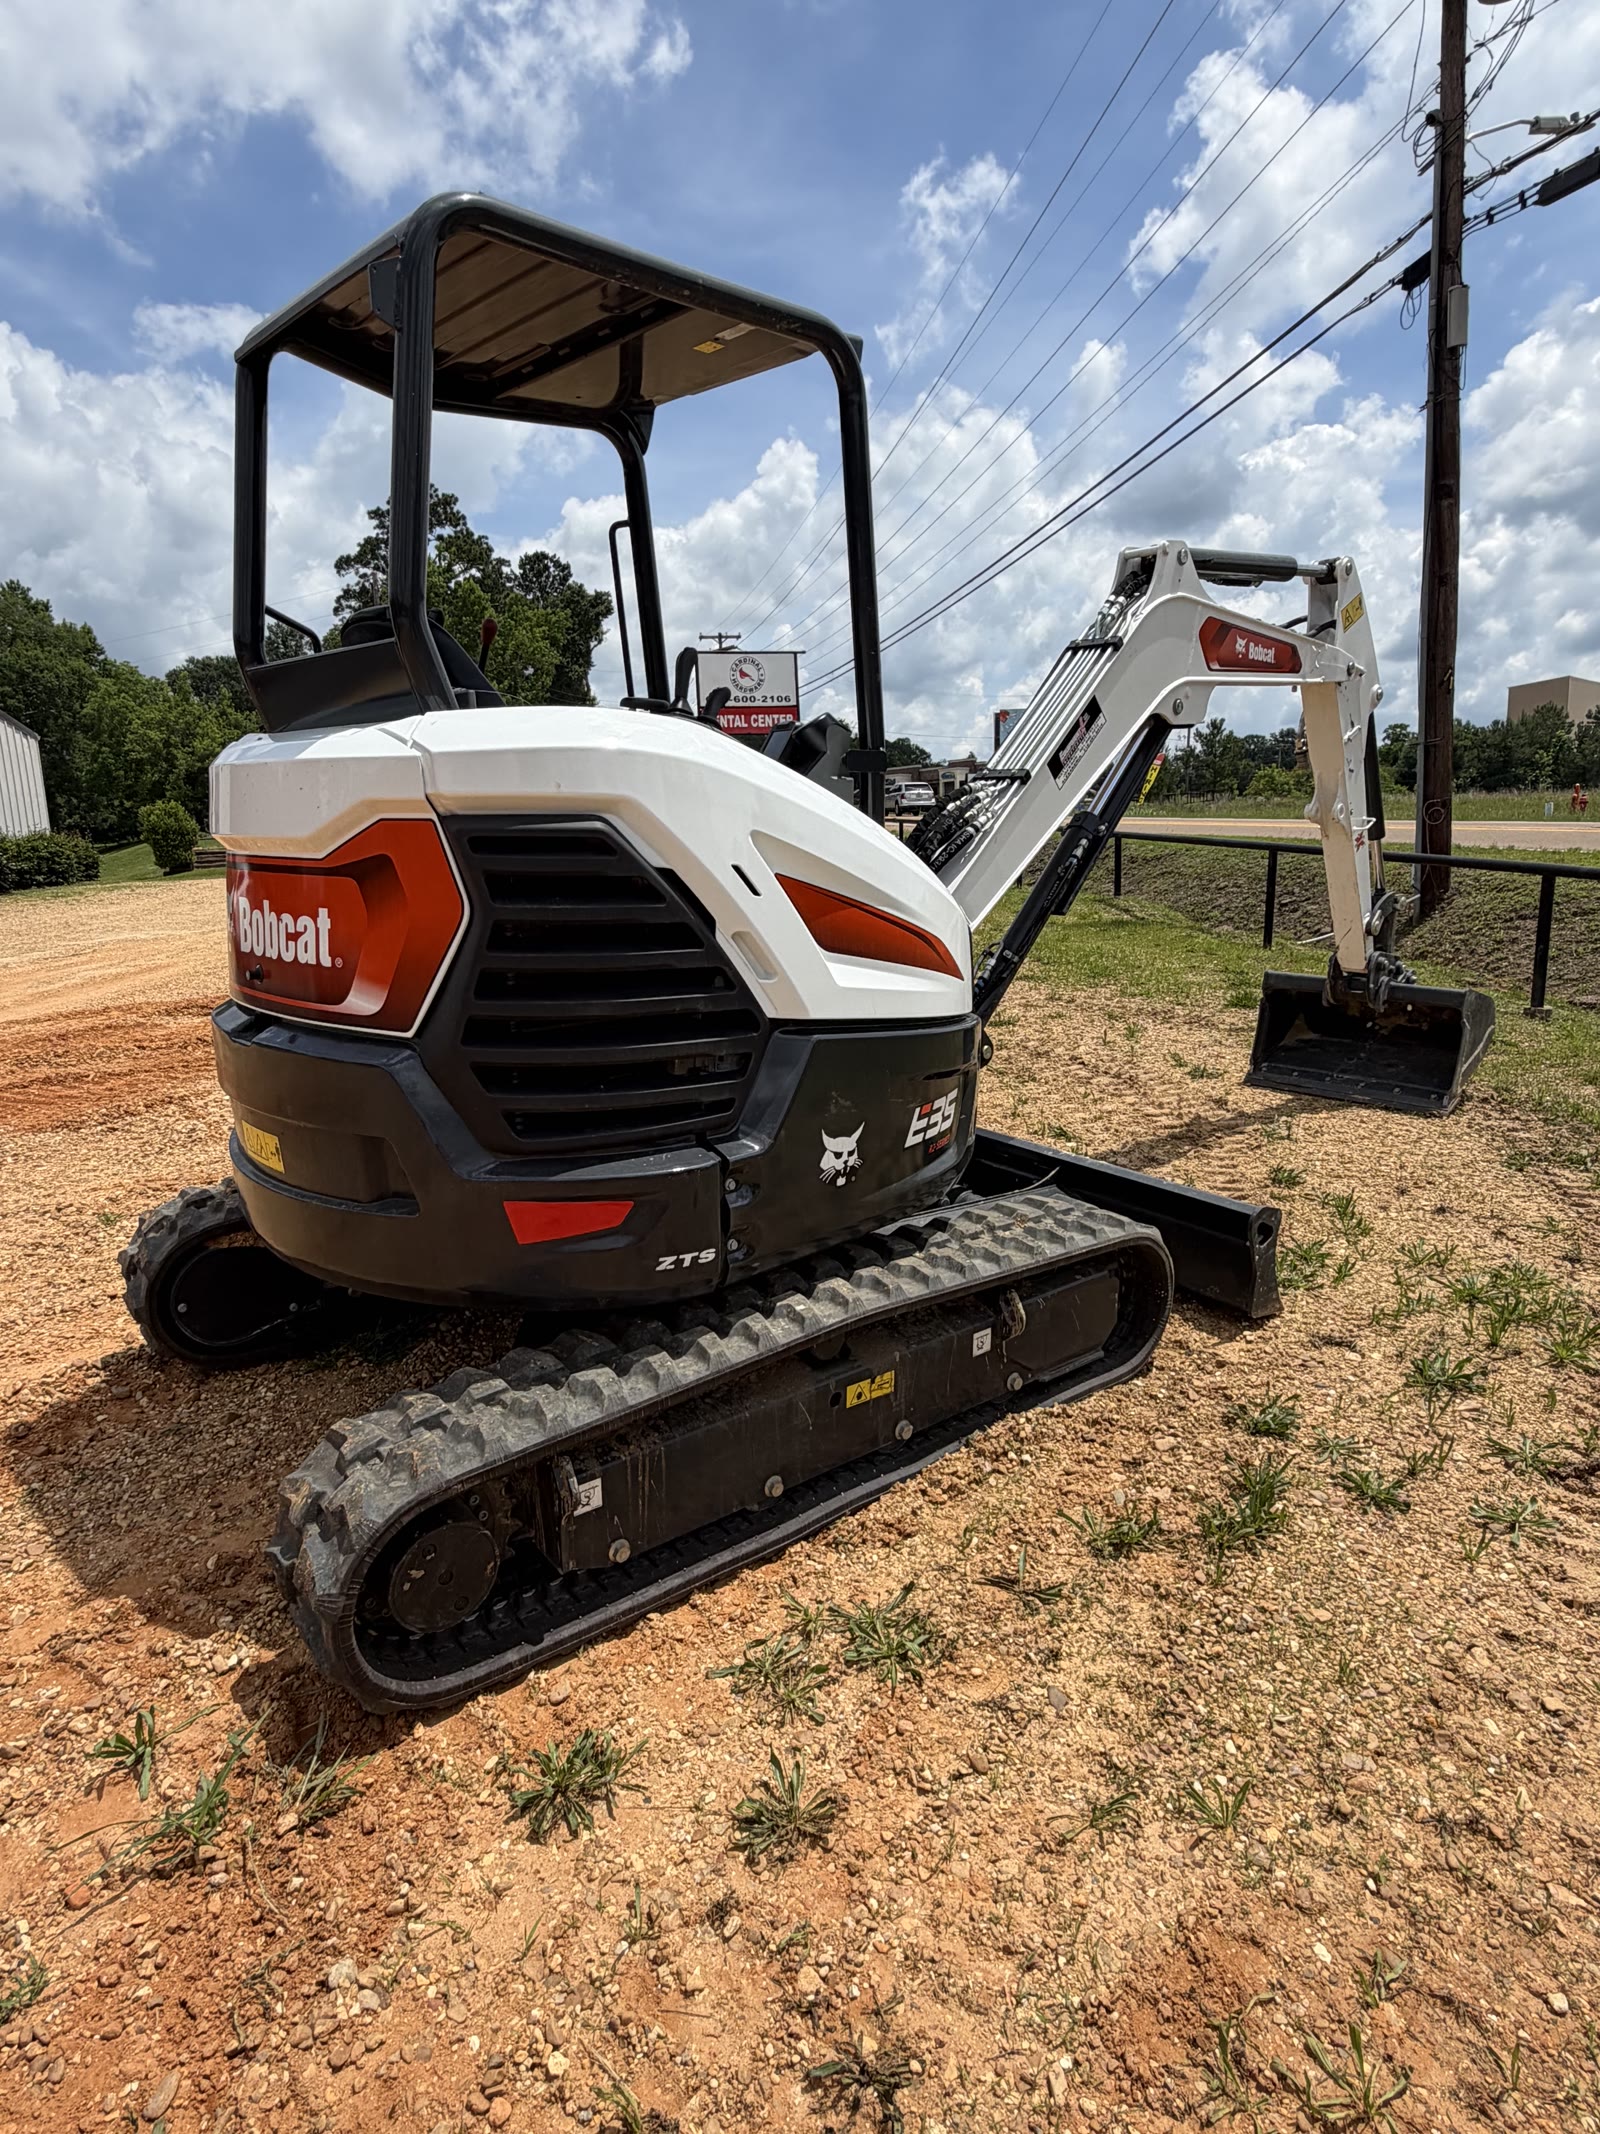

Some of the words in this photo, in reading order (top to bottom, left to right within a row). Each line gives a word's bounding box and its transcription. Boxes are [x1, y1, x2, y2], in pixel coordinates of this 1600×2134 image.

[1248, 642, 1276, 664] Bobcat
[731, 657, 762, 672] CARDINAL
[732, 678, 764, 693] HARDWARE
[728, 694, 792, 703] -600-2106
[239, 896, 333, 968] Bobcat
[904, 1088, 958, 1148] E35
[655, 1248, 716, 1271] ZTS
